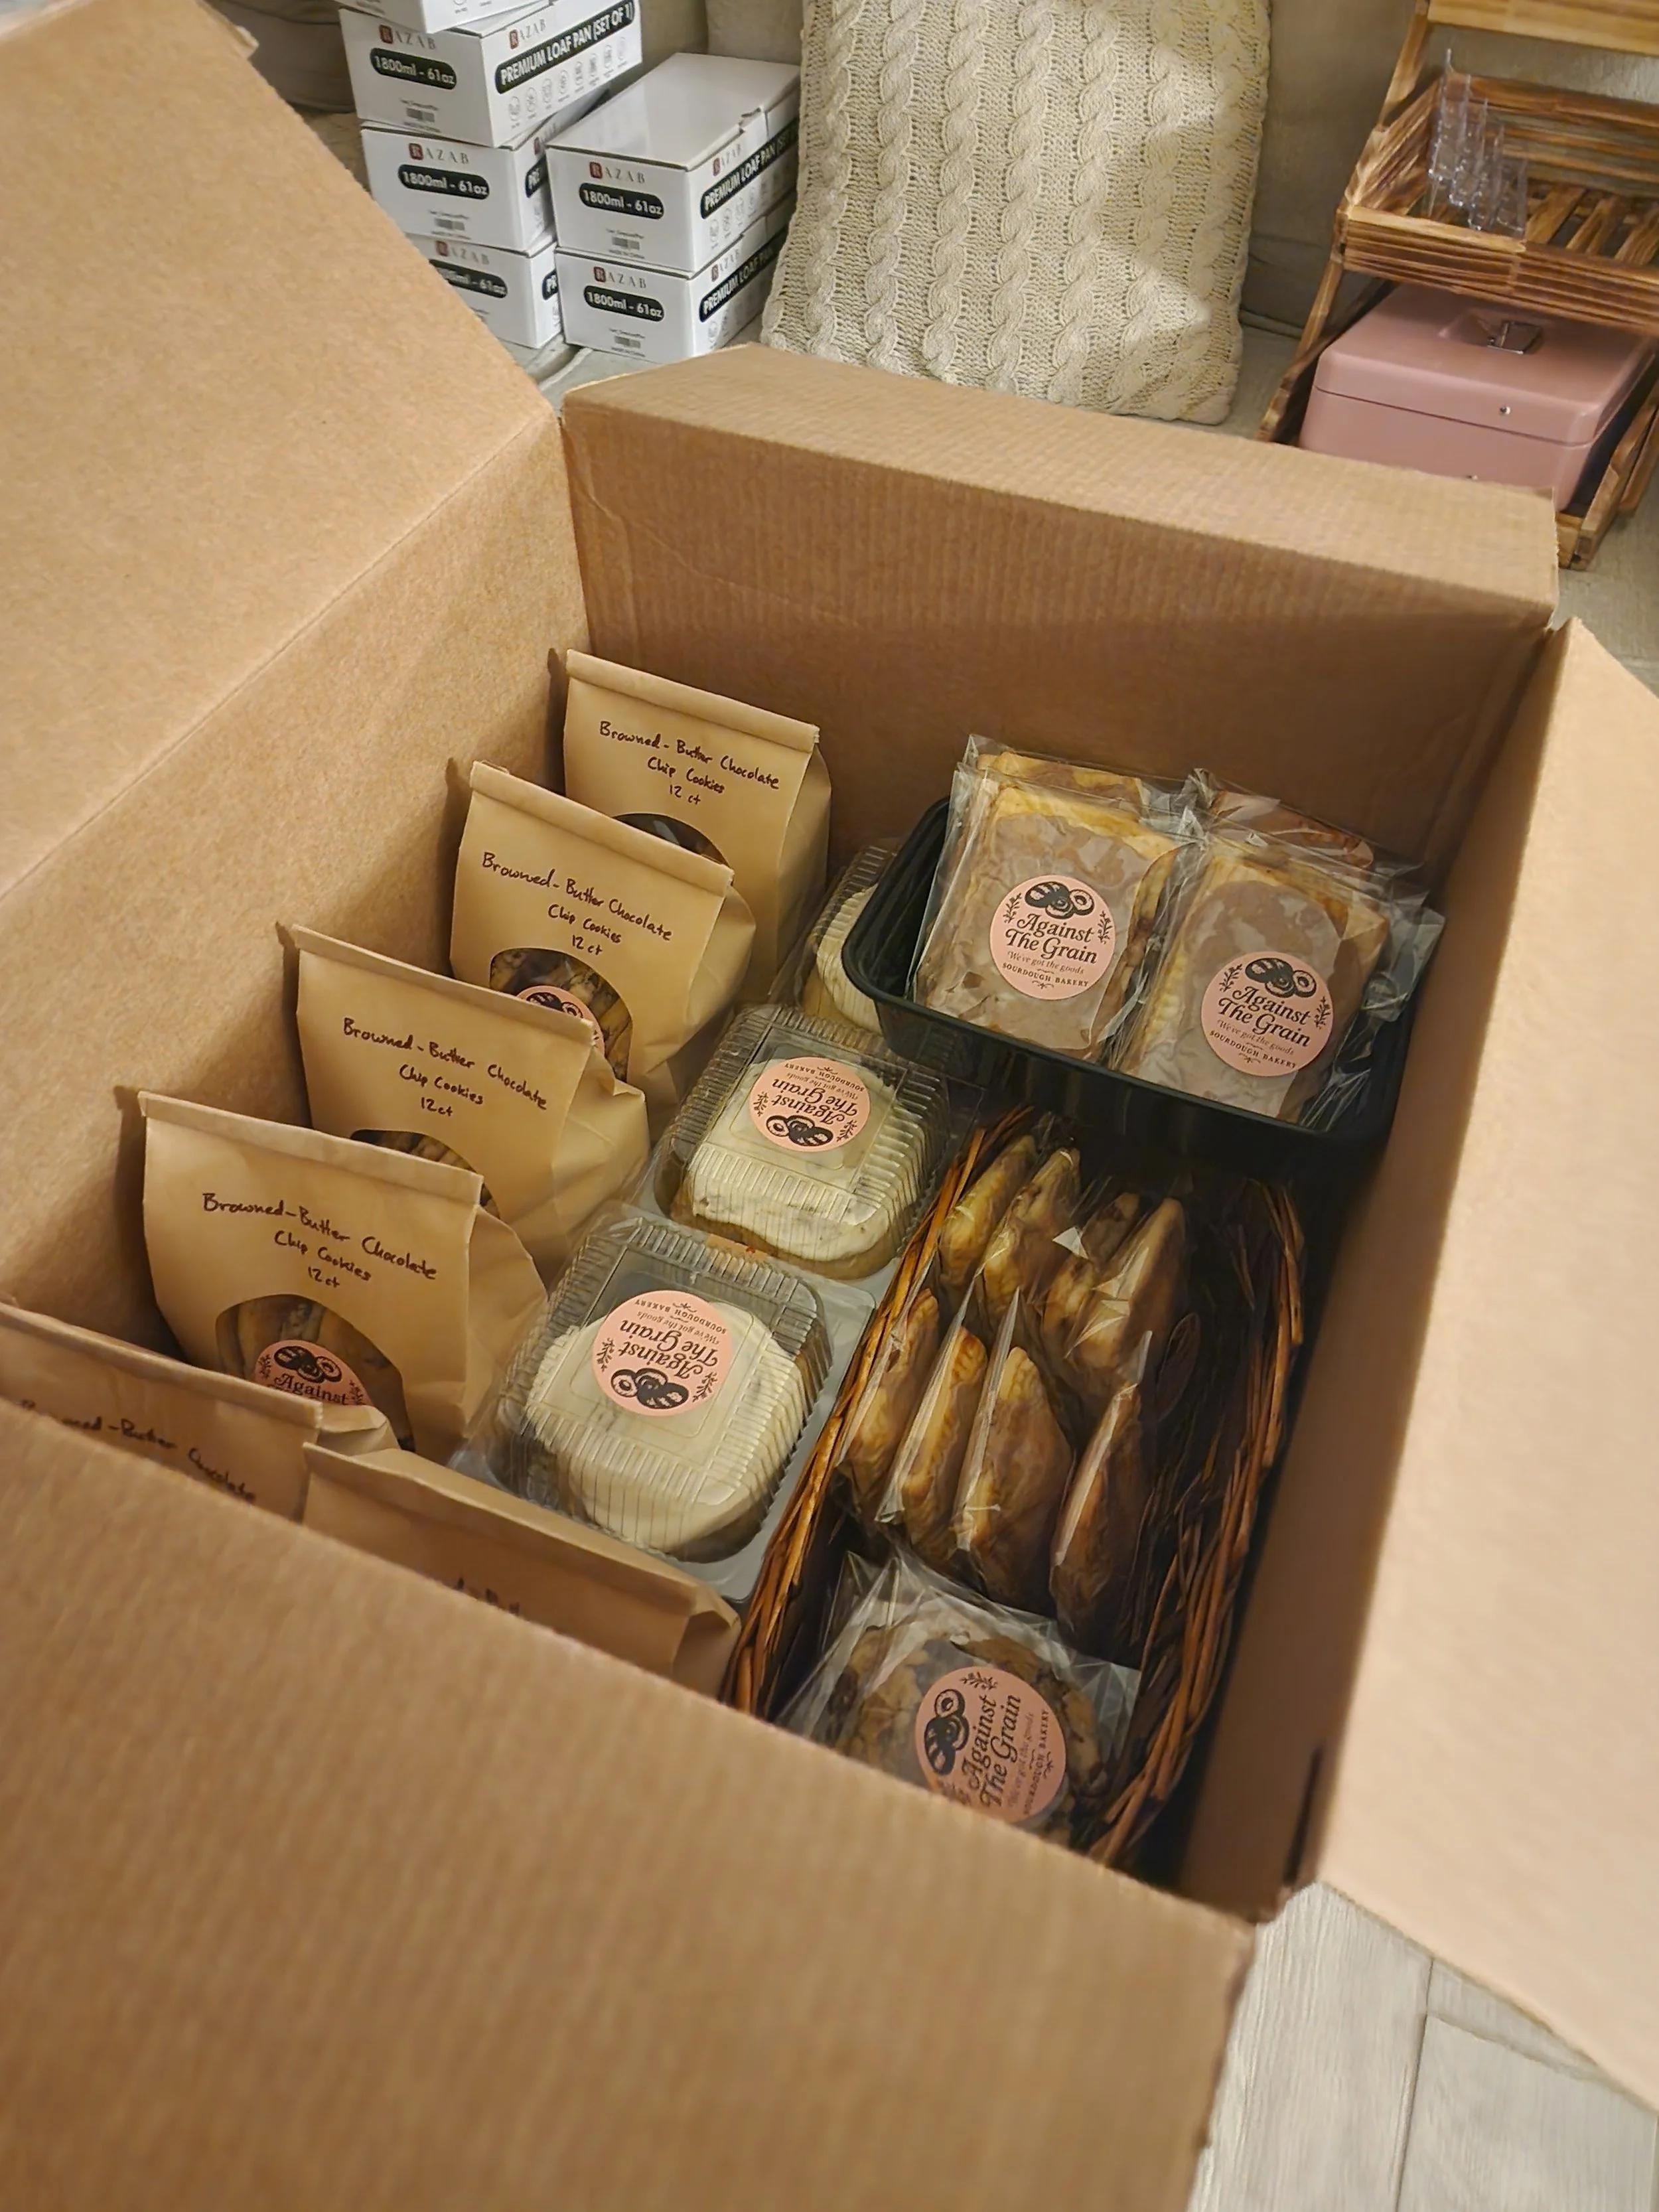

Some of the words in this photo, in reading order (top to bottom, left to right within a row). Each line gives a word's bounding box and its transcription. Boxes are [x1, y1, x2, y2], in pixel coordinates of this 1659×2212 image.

[500, 49, 547, 86] PREMIUM
[547, 36, 572, 61] LOAF
[573, 25, 593, 48] PAN
[611, 7, 624, 26] OF
[374, 55, 416, 76] 1800ml
[427, 68, 455, 85] 61oz
[402, 171, 447, 189] 1800ml
[459, 180, 488, 196] 61oz
[704, 171, 741, 211] PREMIUM
[740, 154, 760, 183] LOAF
[760, 143, 776, 167] PAN
[583, 188, 624, 209] 1800ml
[634, 200, 663, 216] 61oz
[703, 274, 739, 315] PREMIUM
[739, 258, 760, 283] LOAF
[587, 291, 627, 310] 1800ml
[636, 303, 663, 318] 61oz
[648, 756, 676, 778] Chip
[685, 767, 725, 794] Cookies
[720, 755, 780, 790] Chocolate
[669, 784, 682, 798] 12
[548, 904, 576, 924] Chip
[583, 917, 622, 944] Cookies
[609, 898, 672, 942] Chocolate
[1017, 913, 1096, 943] Against
[1005, 928, 1039, 951] The
[1040, 937, 1098, 964] Grain
[1002, 962, 1052, 982] SOURDOUGH
[1054, 977, 1089, 988] BAKERY
[1031, 957, 1045, 968] got
[1046, 960, 1059, 970] the
[1060, 963, 1084, 975] goods
[1218, 997, 1253, 1024] The
[1252, 1013, 1311, 1048] Grain
[1232, 986, 1311, 1026] Against
[1209, 1030, 1260, 1057] SOURDOUGH
[1262, 1053, 1297, 1069] BAKERY
[1256, 1035, 1269, 1047] the
[399, 1063, 429, 1088] Chip
[434, 1076, 484, 1105] Cookies
[784, 1063, 815, 1074] BAKERY
[810, 1080, 823, 1089] the
[818, 1071, 865, 1092] SOURDOUGH
[487, 1063, 547, 1111] Chocolate
[772, 1078, 826, 1104] Grain
[770, 1094, 845, 1125] Against
[826, 1096, 858, 1117] The
[274, 1230, 308, 1255] Chip
[317, 1246, 372, 1282] Cookies
[362, 1236, 438, 1280] Chocolate
[635, 1298, 672, 1313] BAKERY
[636, 1311, 664, 1323] goods
[674, 1309, 727, 1335] SOURDOUGH
[620, 1319, 682, 1352] Grain
[664, 1319, 678, 1329] the
[679, 1323, 695, 1336] got
[618, 1341, 703, 1380] Against
[682, 1341, 719, 1367] The
[273, 1373, 350, 1406] Against
[962, 1694, 997, 1791] Against
[990, 1694, 1021, 1763] Grain
[1039, 1708, 1050, 1750] BAKERY
[979, 1763, 1007, 1808] The
